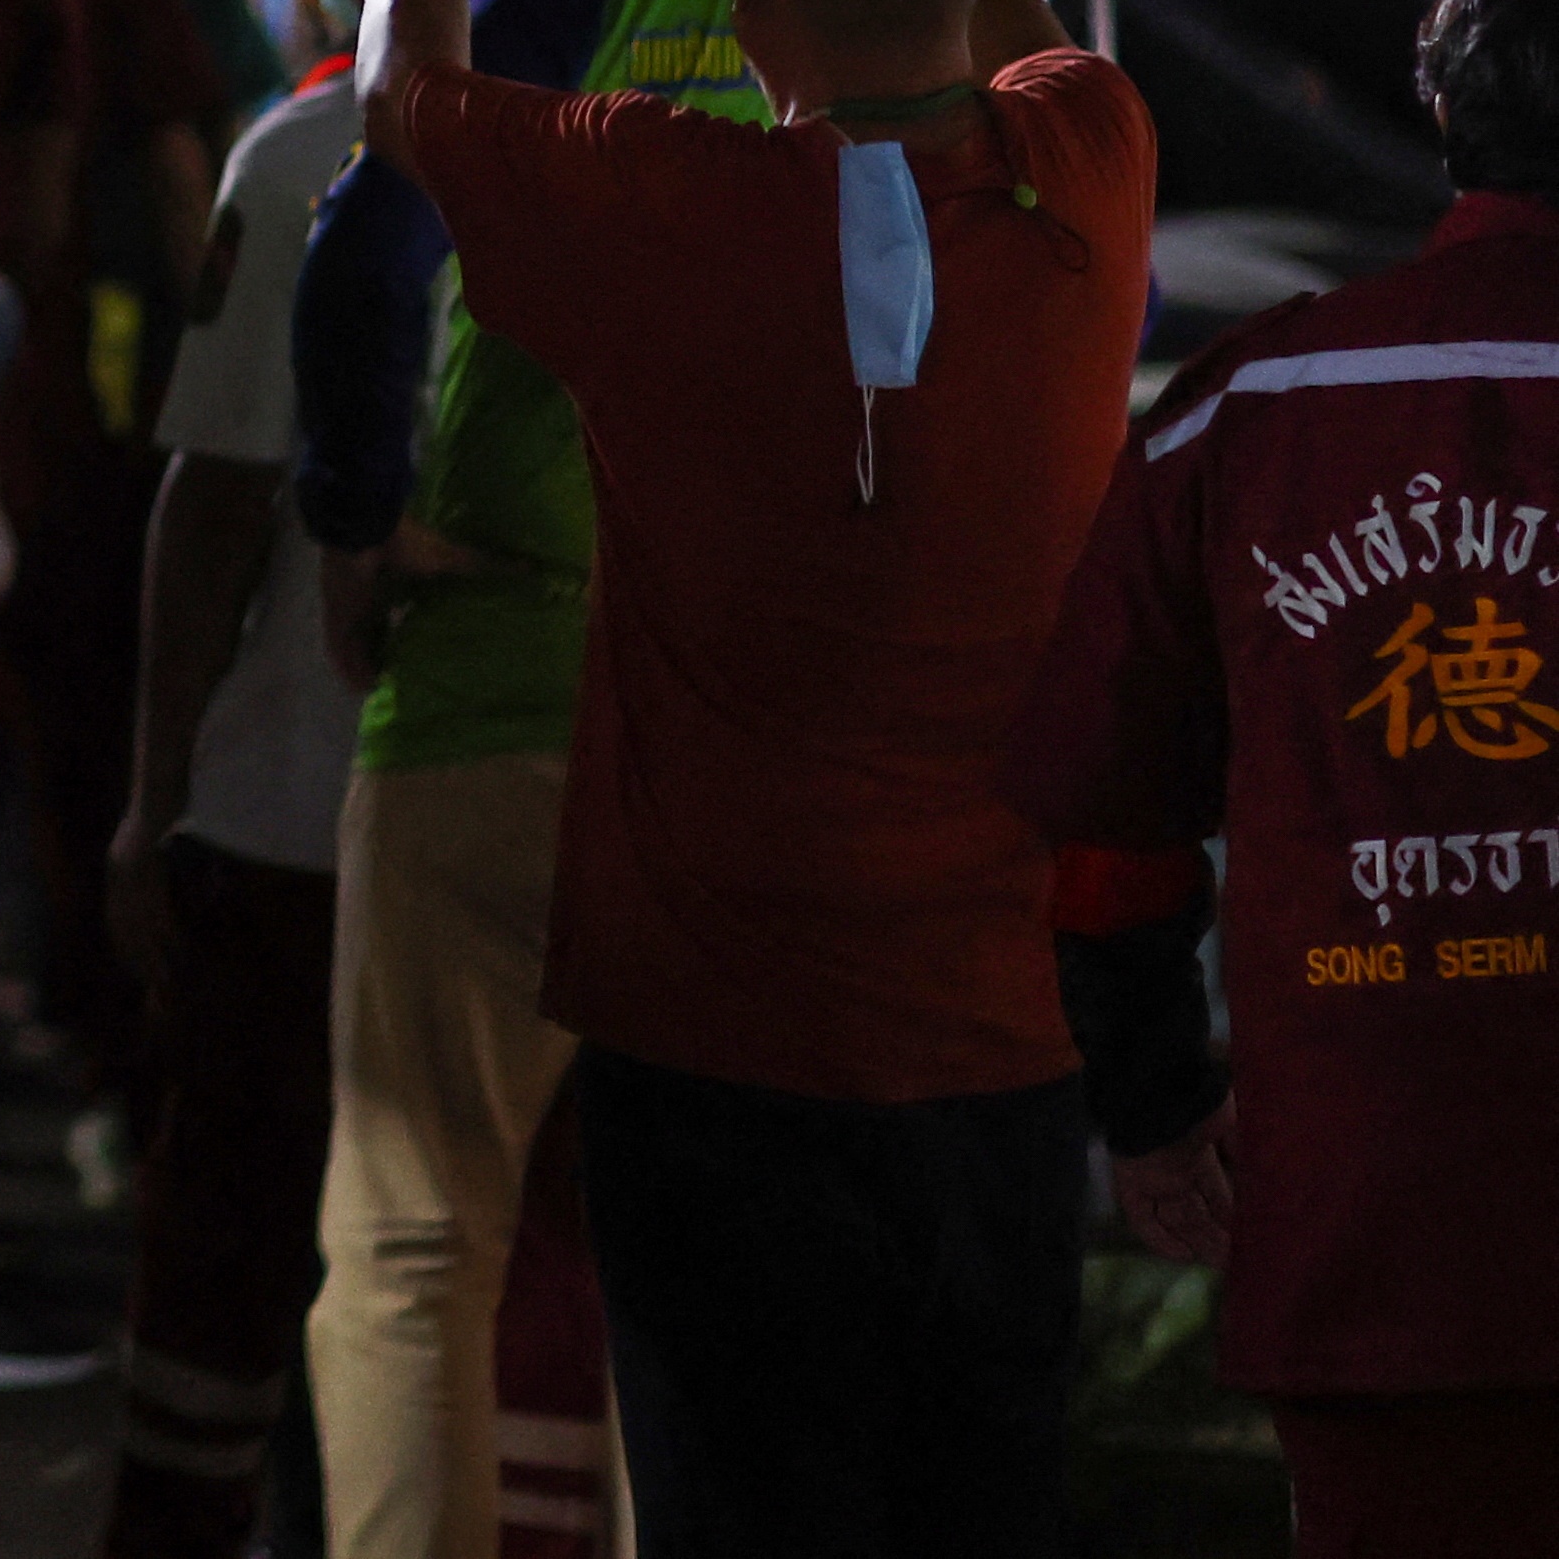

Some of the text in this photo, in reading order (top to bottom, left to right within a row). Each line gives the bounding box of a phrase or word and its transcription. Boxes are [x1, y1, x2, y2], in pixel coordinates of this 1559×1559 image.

[1343, 596, 1559, 762] 德
[1306, 933, 1548, 986] SONG SERM
